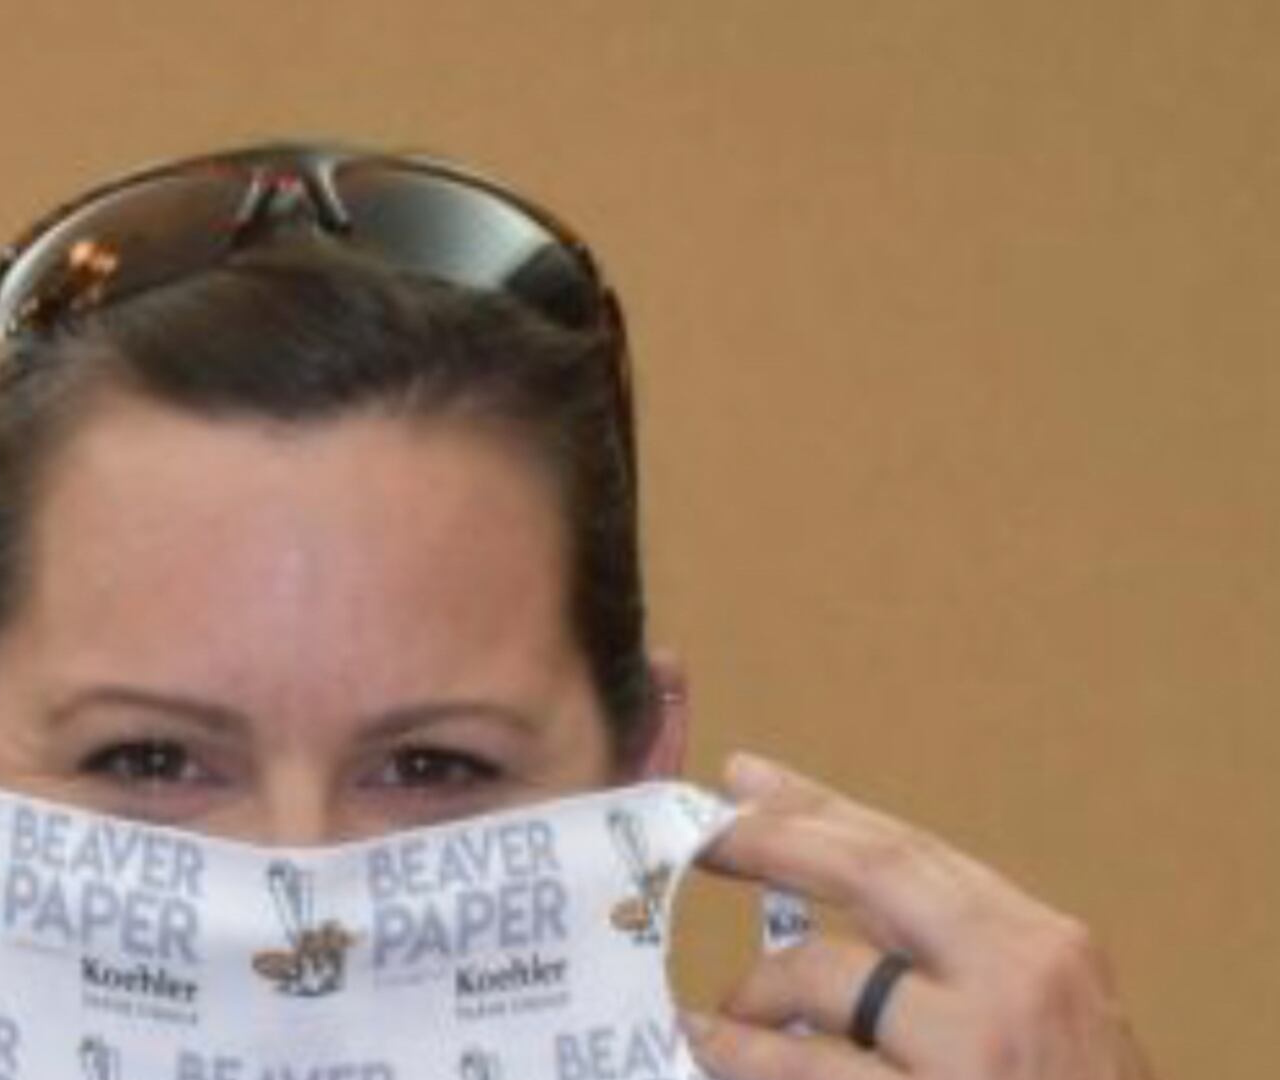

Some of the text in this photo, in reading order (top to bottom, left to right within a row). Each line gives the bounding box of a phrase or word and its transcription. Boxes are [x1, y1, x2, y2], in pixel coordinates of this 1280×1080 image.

[9, 805, 204, 894] BEAVER
[366, 820, 560, 900] BEAVER
[3, 862, 201, 964] PAPER
[372, 880, 569, 968] PAPER
[81, 954, 198, 1003] Koehler
[455, 952, 568, 998] Koehler
